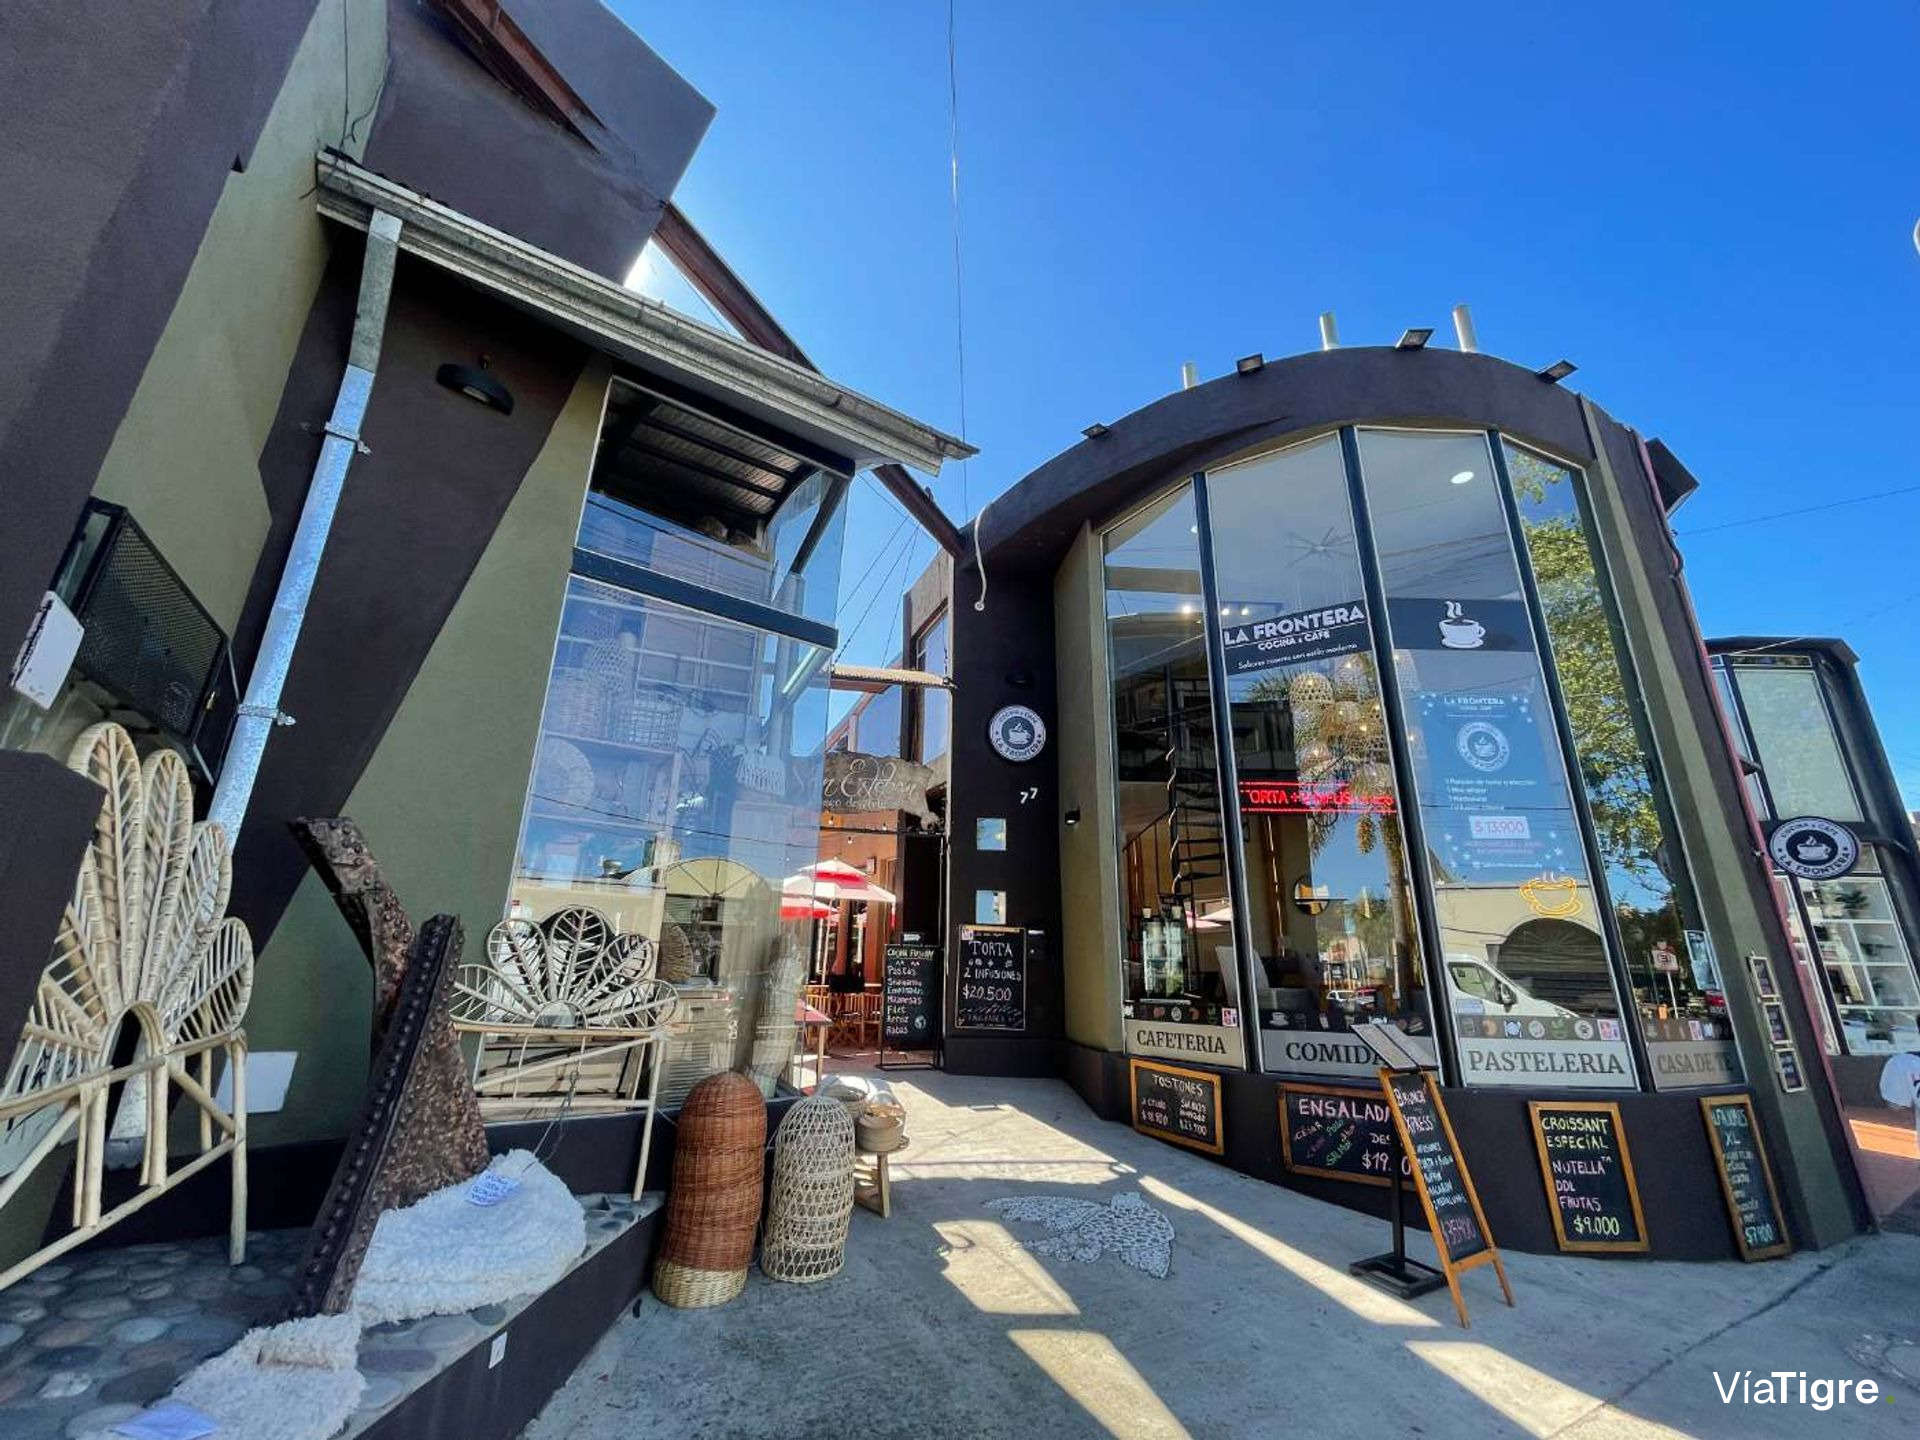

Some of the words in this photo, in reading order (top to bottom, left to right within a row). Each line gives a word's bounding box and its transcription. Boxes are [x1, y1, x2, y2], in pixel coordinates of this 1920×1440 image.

[1224, 629, 1249, 646] LA
[1253, 605, 1365, 640] FRONTERA
[1258, 636, 1296, 651] COCINA
[968, 940, 1014, 957] TORTA
[964, 967, 971, 978] 2
[975, 968, 1021, 982] INFUSIONES
[1136, 1029, 1228, 1054] CAFETERIA
[1468, 1051, 1626, 1074] PASTELERIA
[1658, 1053, 1695, 1074] CASA
[1694, 1053, 1714, 1072] DE
[1152, 1073, 1203, 1097] TOSTONES
[1541, 1117, 1608, 1135] CROISSANT
[1547, 1134, 1609, 1150] ESPECIAL
[1725, 1131, 1742, 1146] XL
[1555, 1180, 1576, 1192] DDL
[1559, 1196, 1602, 1212] FRUTAS
[1573, 1215, 1620, 1236] $9.000
